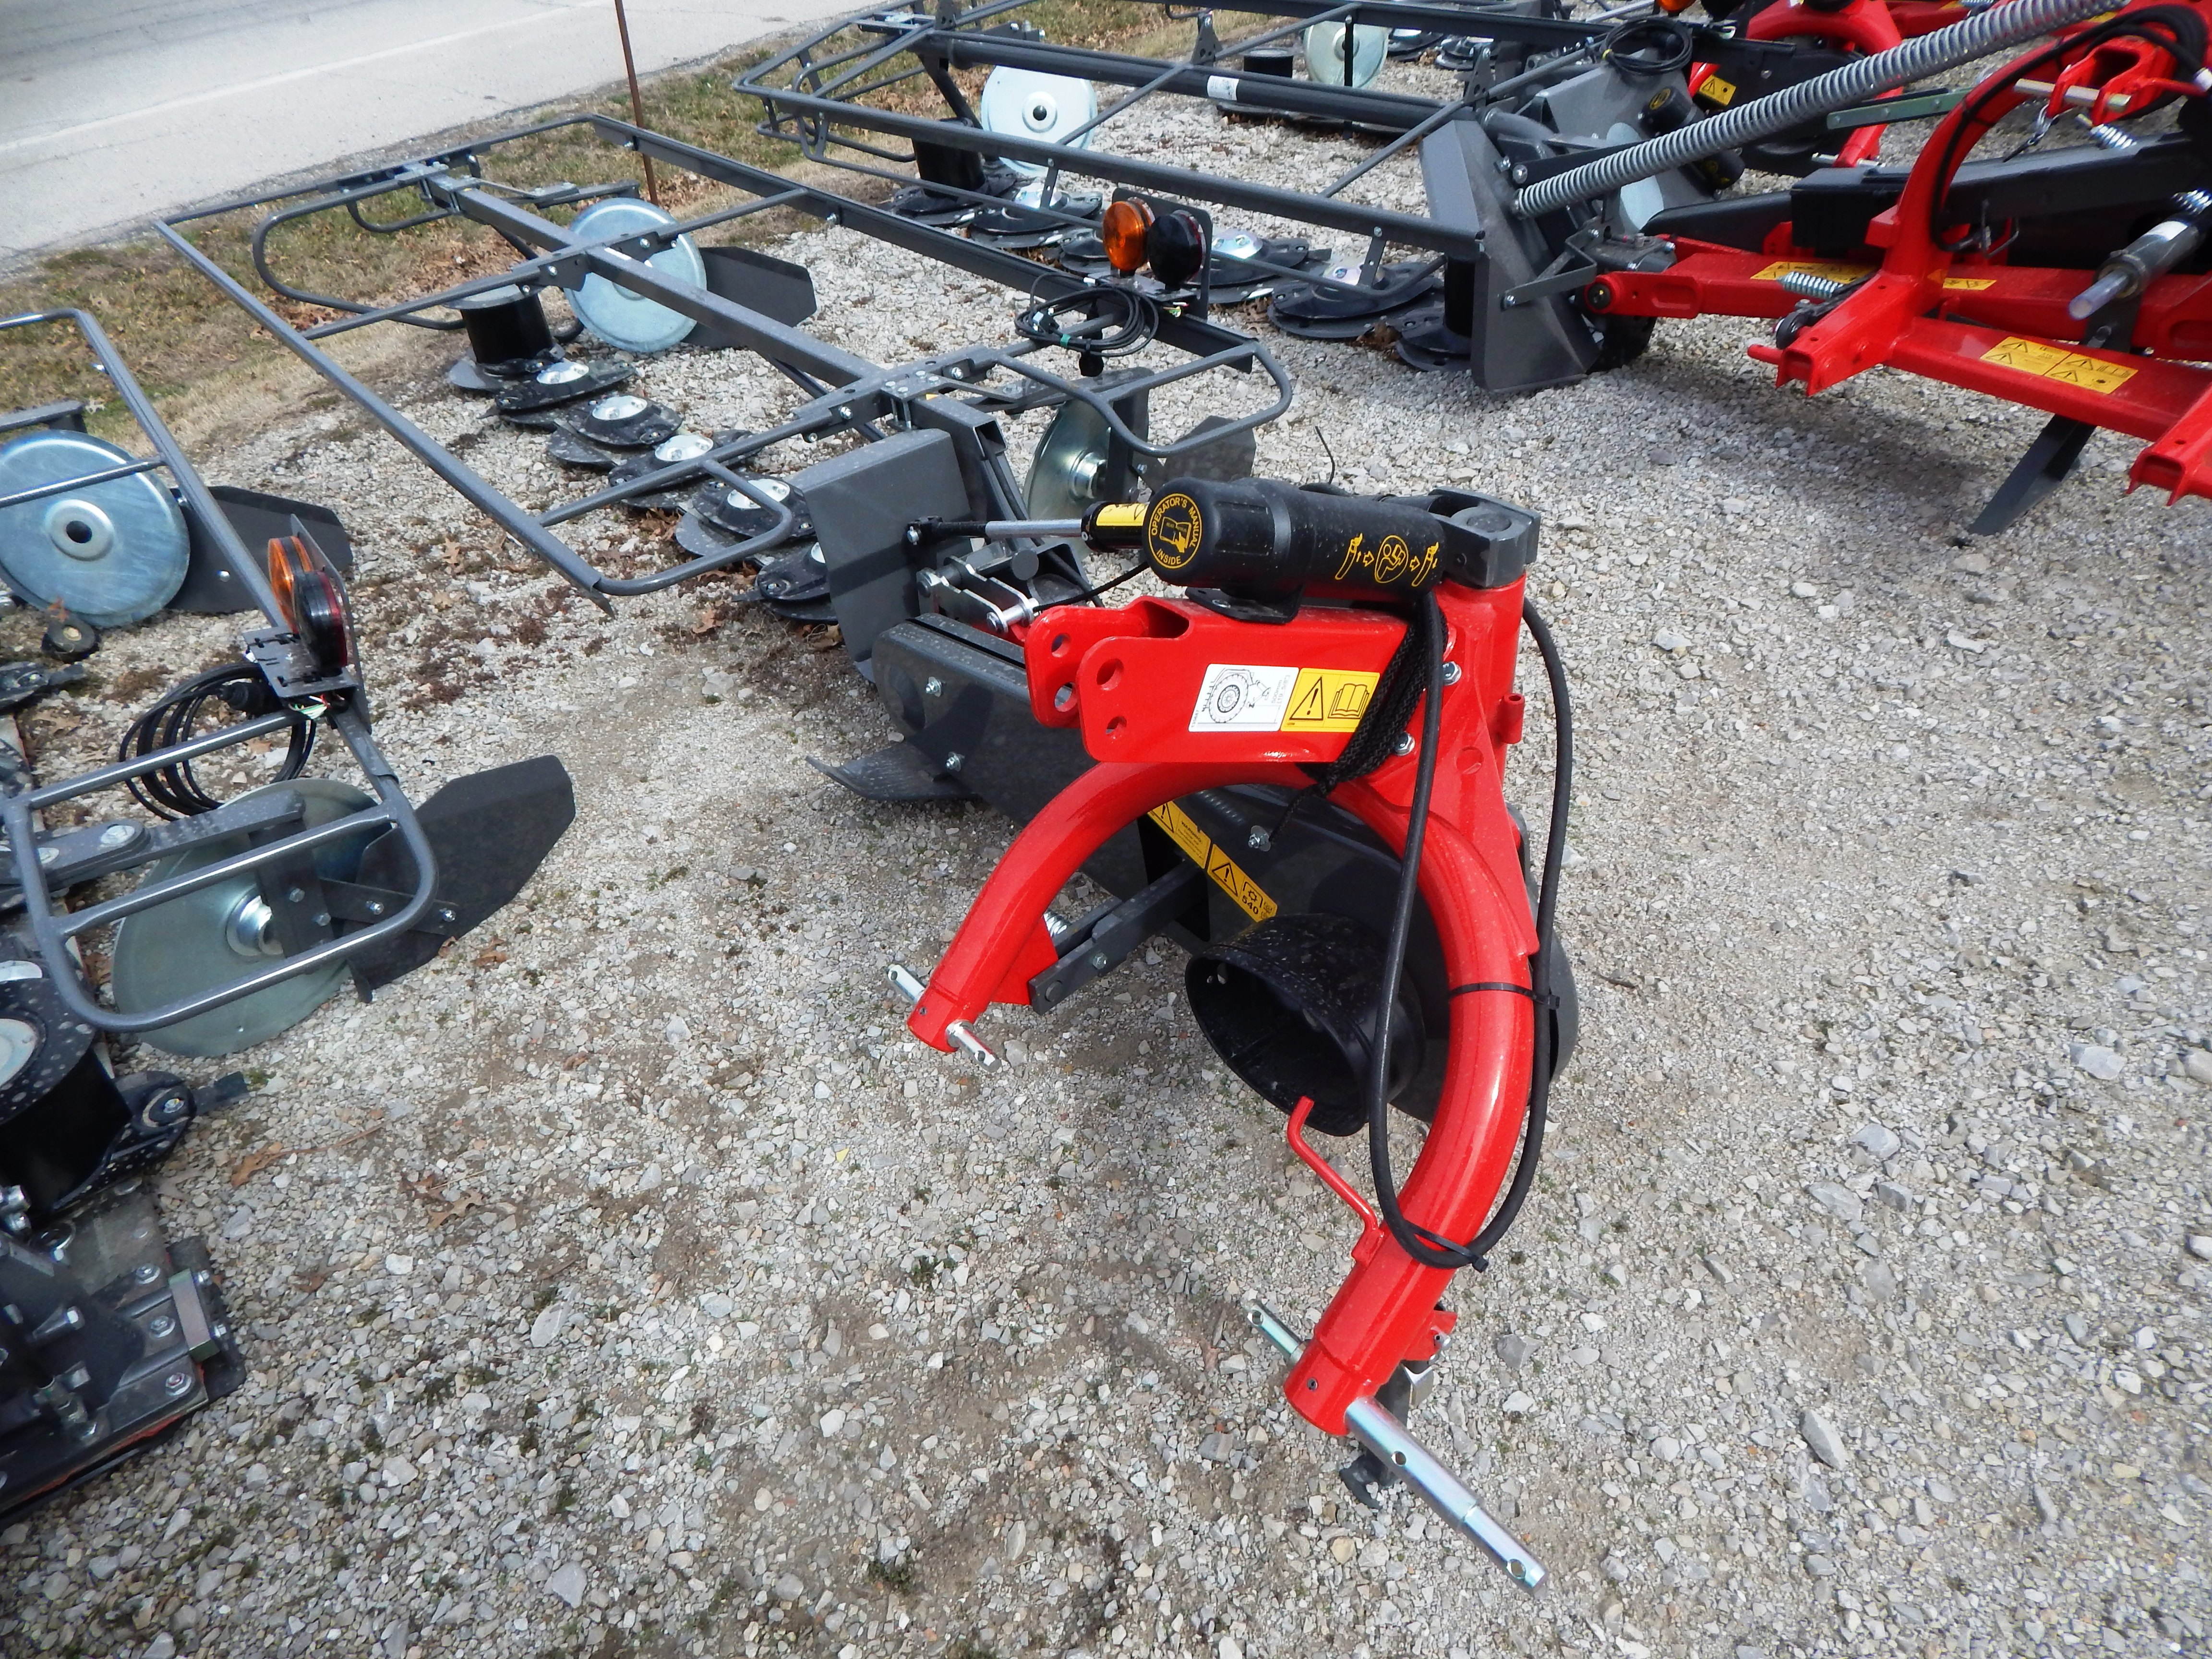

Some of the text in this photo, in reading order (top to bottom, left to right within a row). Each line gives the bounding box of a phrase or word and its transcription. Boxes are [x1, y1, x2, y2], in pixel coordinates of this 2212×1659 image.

[1151, 497, 1200, 548] OPERATOR'S MANUAL
[1156, 548, 1182, 565] INSIDE
[1271, 680, 1282, 704] 500mm
[1242, 895, 1259, 914] 540
